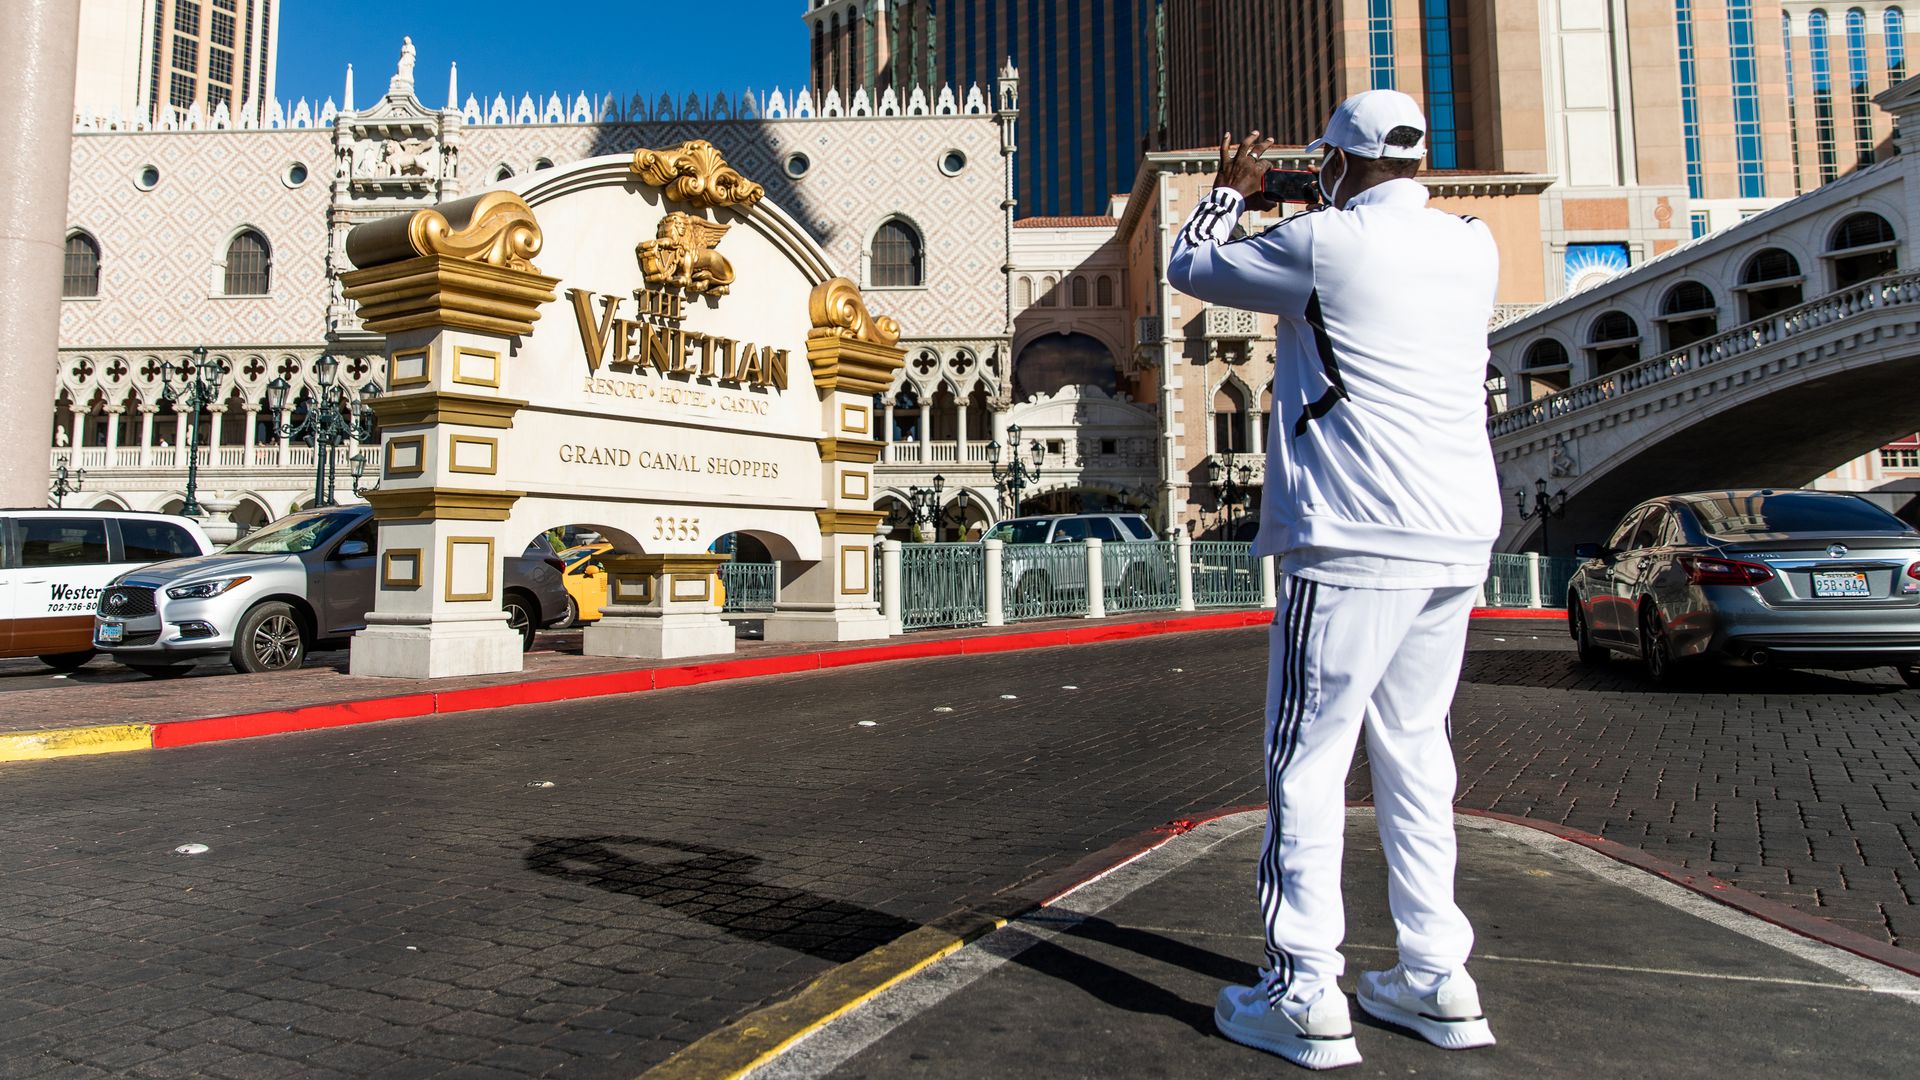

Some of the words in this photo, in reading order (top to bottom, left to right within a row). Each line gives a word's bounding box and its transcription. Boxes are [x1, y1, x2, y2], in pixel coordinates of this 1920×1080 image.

[632, 288, 688, 321] THE
[565, 287, 791, 391] VENETIAN
[583, 376, 648, 400] RESORT
[658, 386, 709, 408] HOTEL
[720, 395, 769, 416] CASINO
[559, 444, 632, 467] GRAND
[638, 450, 701, 473] CANAL
[707, 457, 779, 479] SHOPPES
[652, 515, 701, 542] 3355
